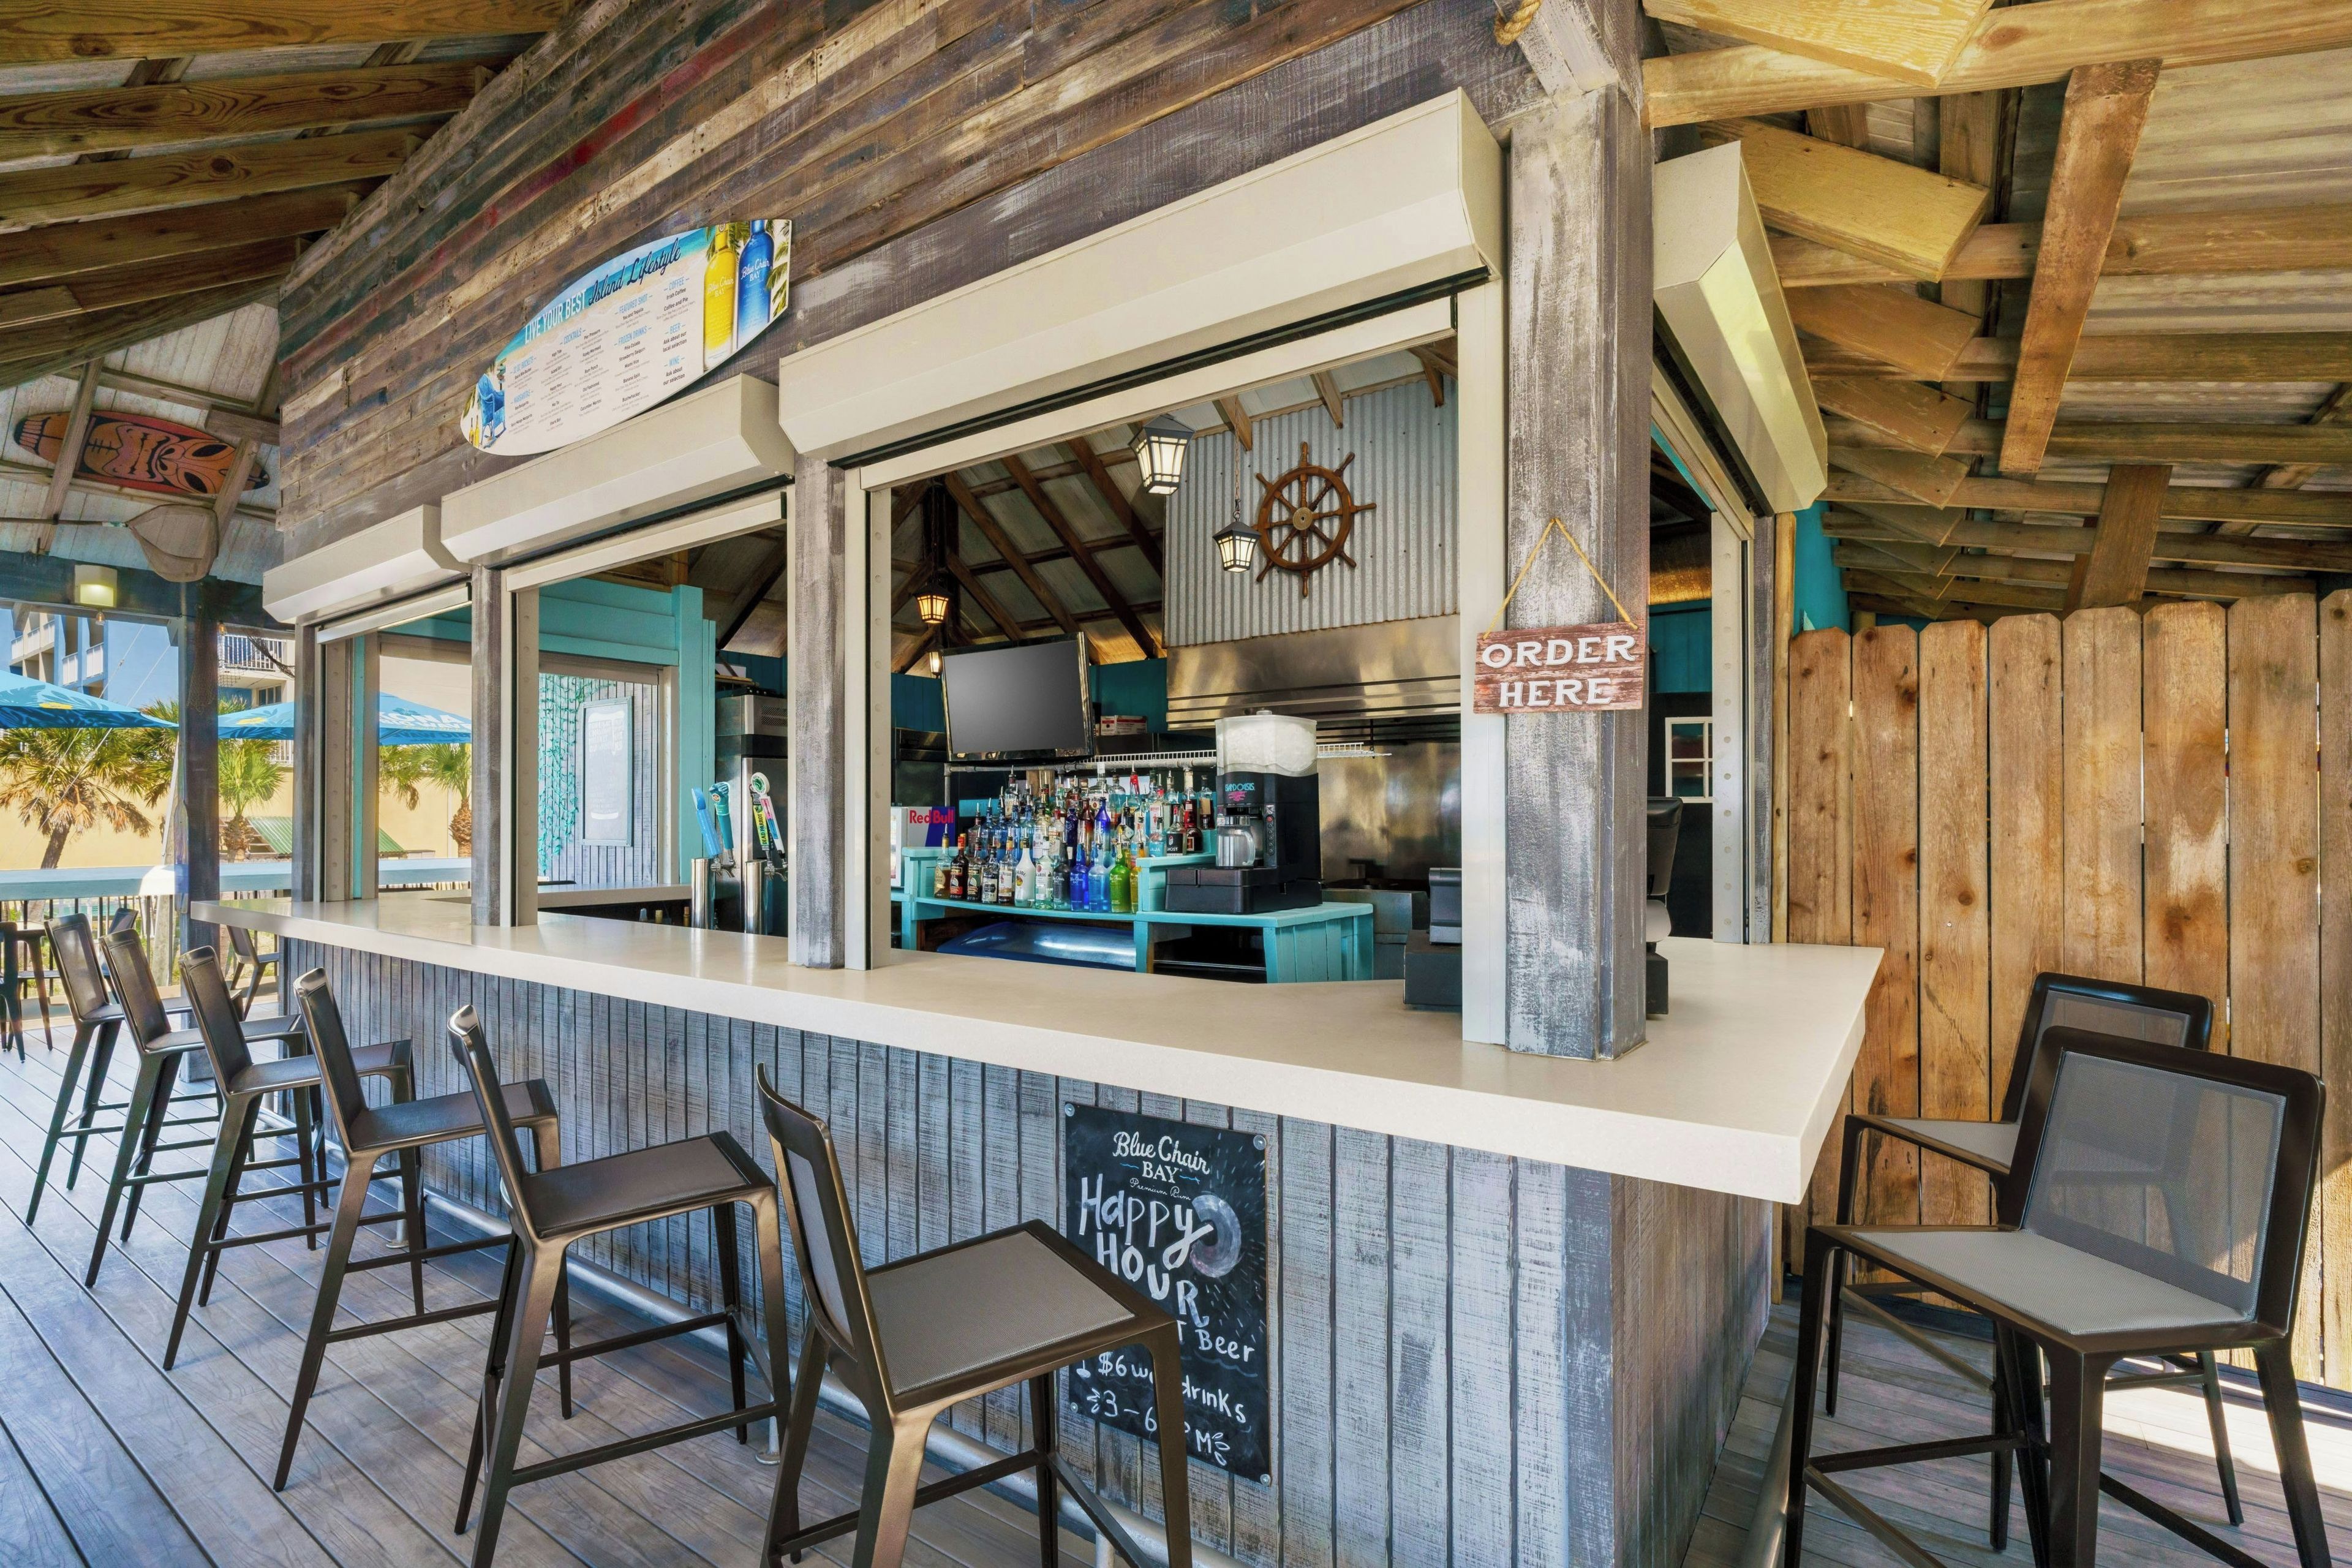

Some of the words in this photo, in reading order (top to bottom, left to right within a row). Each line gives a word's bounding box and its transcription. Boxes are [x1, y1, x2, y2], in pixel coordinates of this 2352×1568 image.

[741, 265, 755, 280] Blue
[755, 258, 770, 270] Chair
[750, 270, 760, 281] BAY
[525, 319, 541, 344] LIVE
[542, 306, 564, 333] YOUR
[565, 290, 586, 320] BEST
[589, 266, 625, 306] Island
[627, 238, 681, 285] Lifestyle
[669, 277, 685, 290] COFFEE
[720, 277, 734, 287] Chair
[619, 297, 638, 313] FEATURED
[638, 294, 647, 307] SHOT
[564, 328, 582, 344] COCKTAILS
[618, 333, 632, 346] FROZEN
[633, 325, 647, 339] DRINKS
[669, 323, 681, 334] BEER
[671, 339, 687, 349] selection
[619, 353, 634, 363] Strawberry
[669, 356, 679, 367] WINE
[670, 373, 685, 383] selection
[1482, 636, 1636, 668] ORDER
[1499, 678, 1613, 707] HERE
[910, 810, 931, 824] Red
[933, 810, 954, 824] Bull
[1112, 1131, 1156, 1159] Blue
[1158, 1136, 1210, 1175] Chair
[1142, 1161, 1177, 1183] BAY
[1129, 1177, 1167, 1196] Premium
[1170, 1186, 1191, 1200] Rum
[1079, 1174, 1213, 1270] Happy
[1096, 1232, 1209, 1328] HOUR
[1195, 1329, 1255, 1362] Beer
[1098, 1351, 1127, 1377] $6
